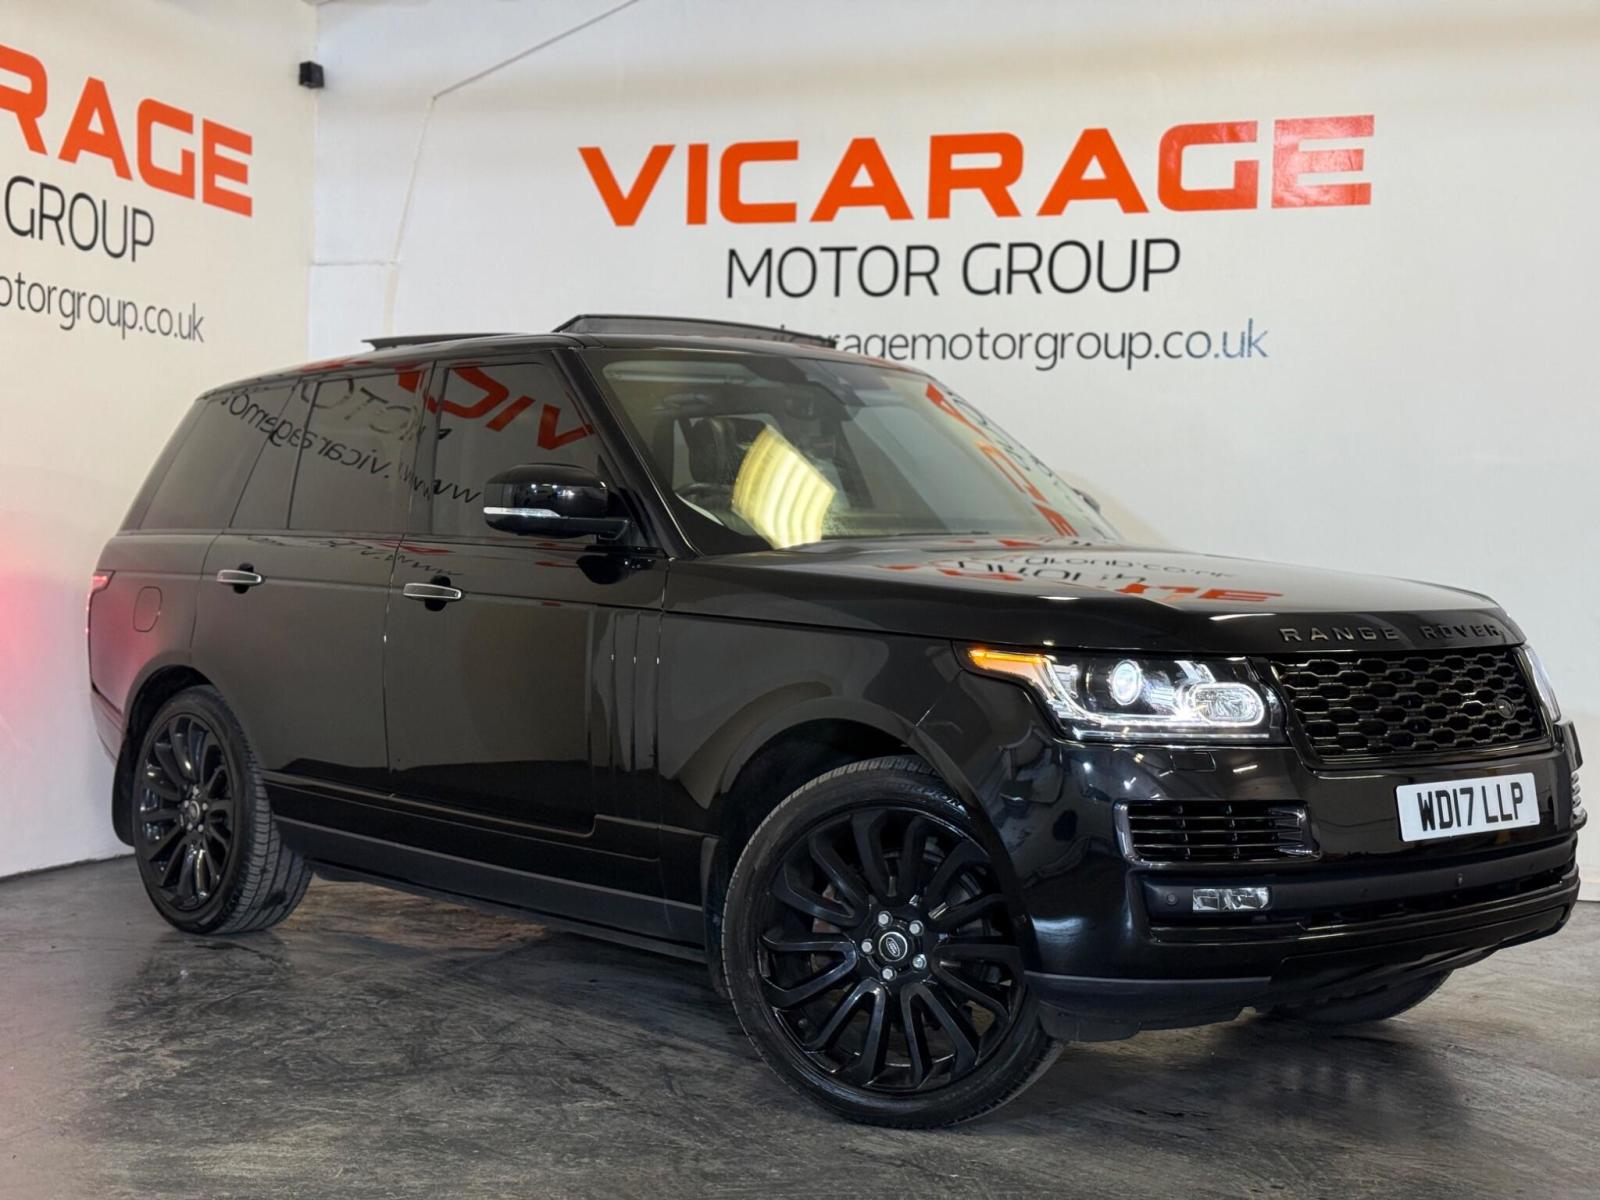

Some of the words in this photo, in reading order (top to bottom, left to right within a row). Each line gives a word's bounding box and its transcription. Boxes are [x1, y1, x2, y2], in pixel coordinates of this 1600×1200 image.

[0, 44, 253, 218] RAGE
[578, 115, 1375, 228] VICARAGE
[4, 175, 155, 263] GROUP
[727, 244, 940, 299] MOTOR
[962, 238, 1182, 296] GROUP
[1279, 626, 1400, 642] RANGE
[1420, 623, 1503, 640] ROVER
[1416, 786, 1475, 832] WD17
[1481, 781, 1524, 824] LLP
